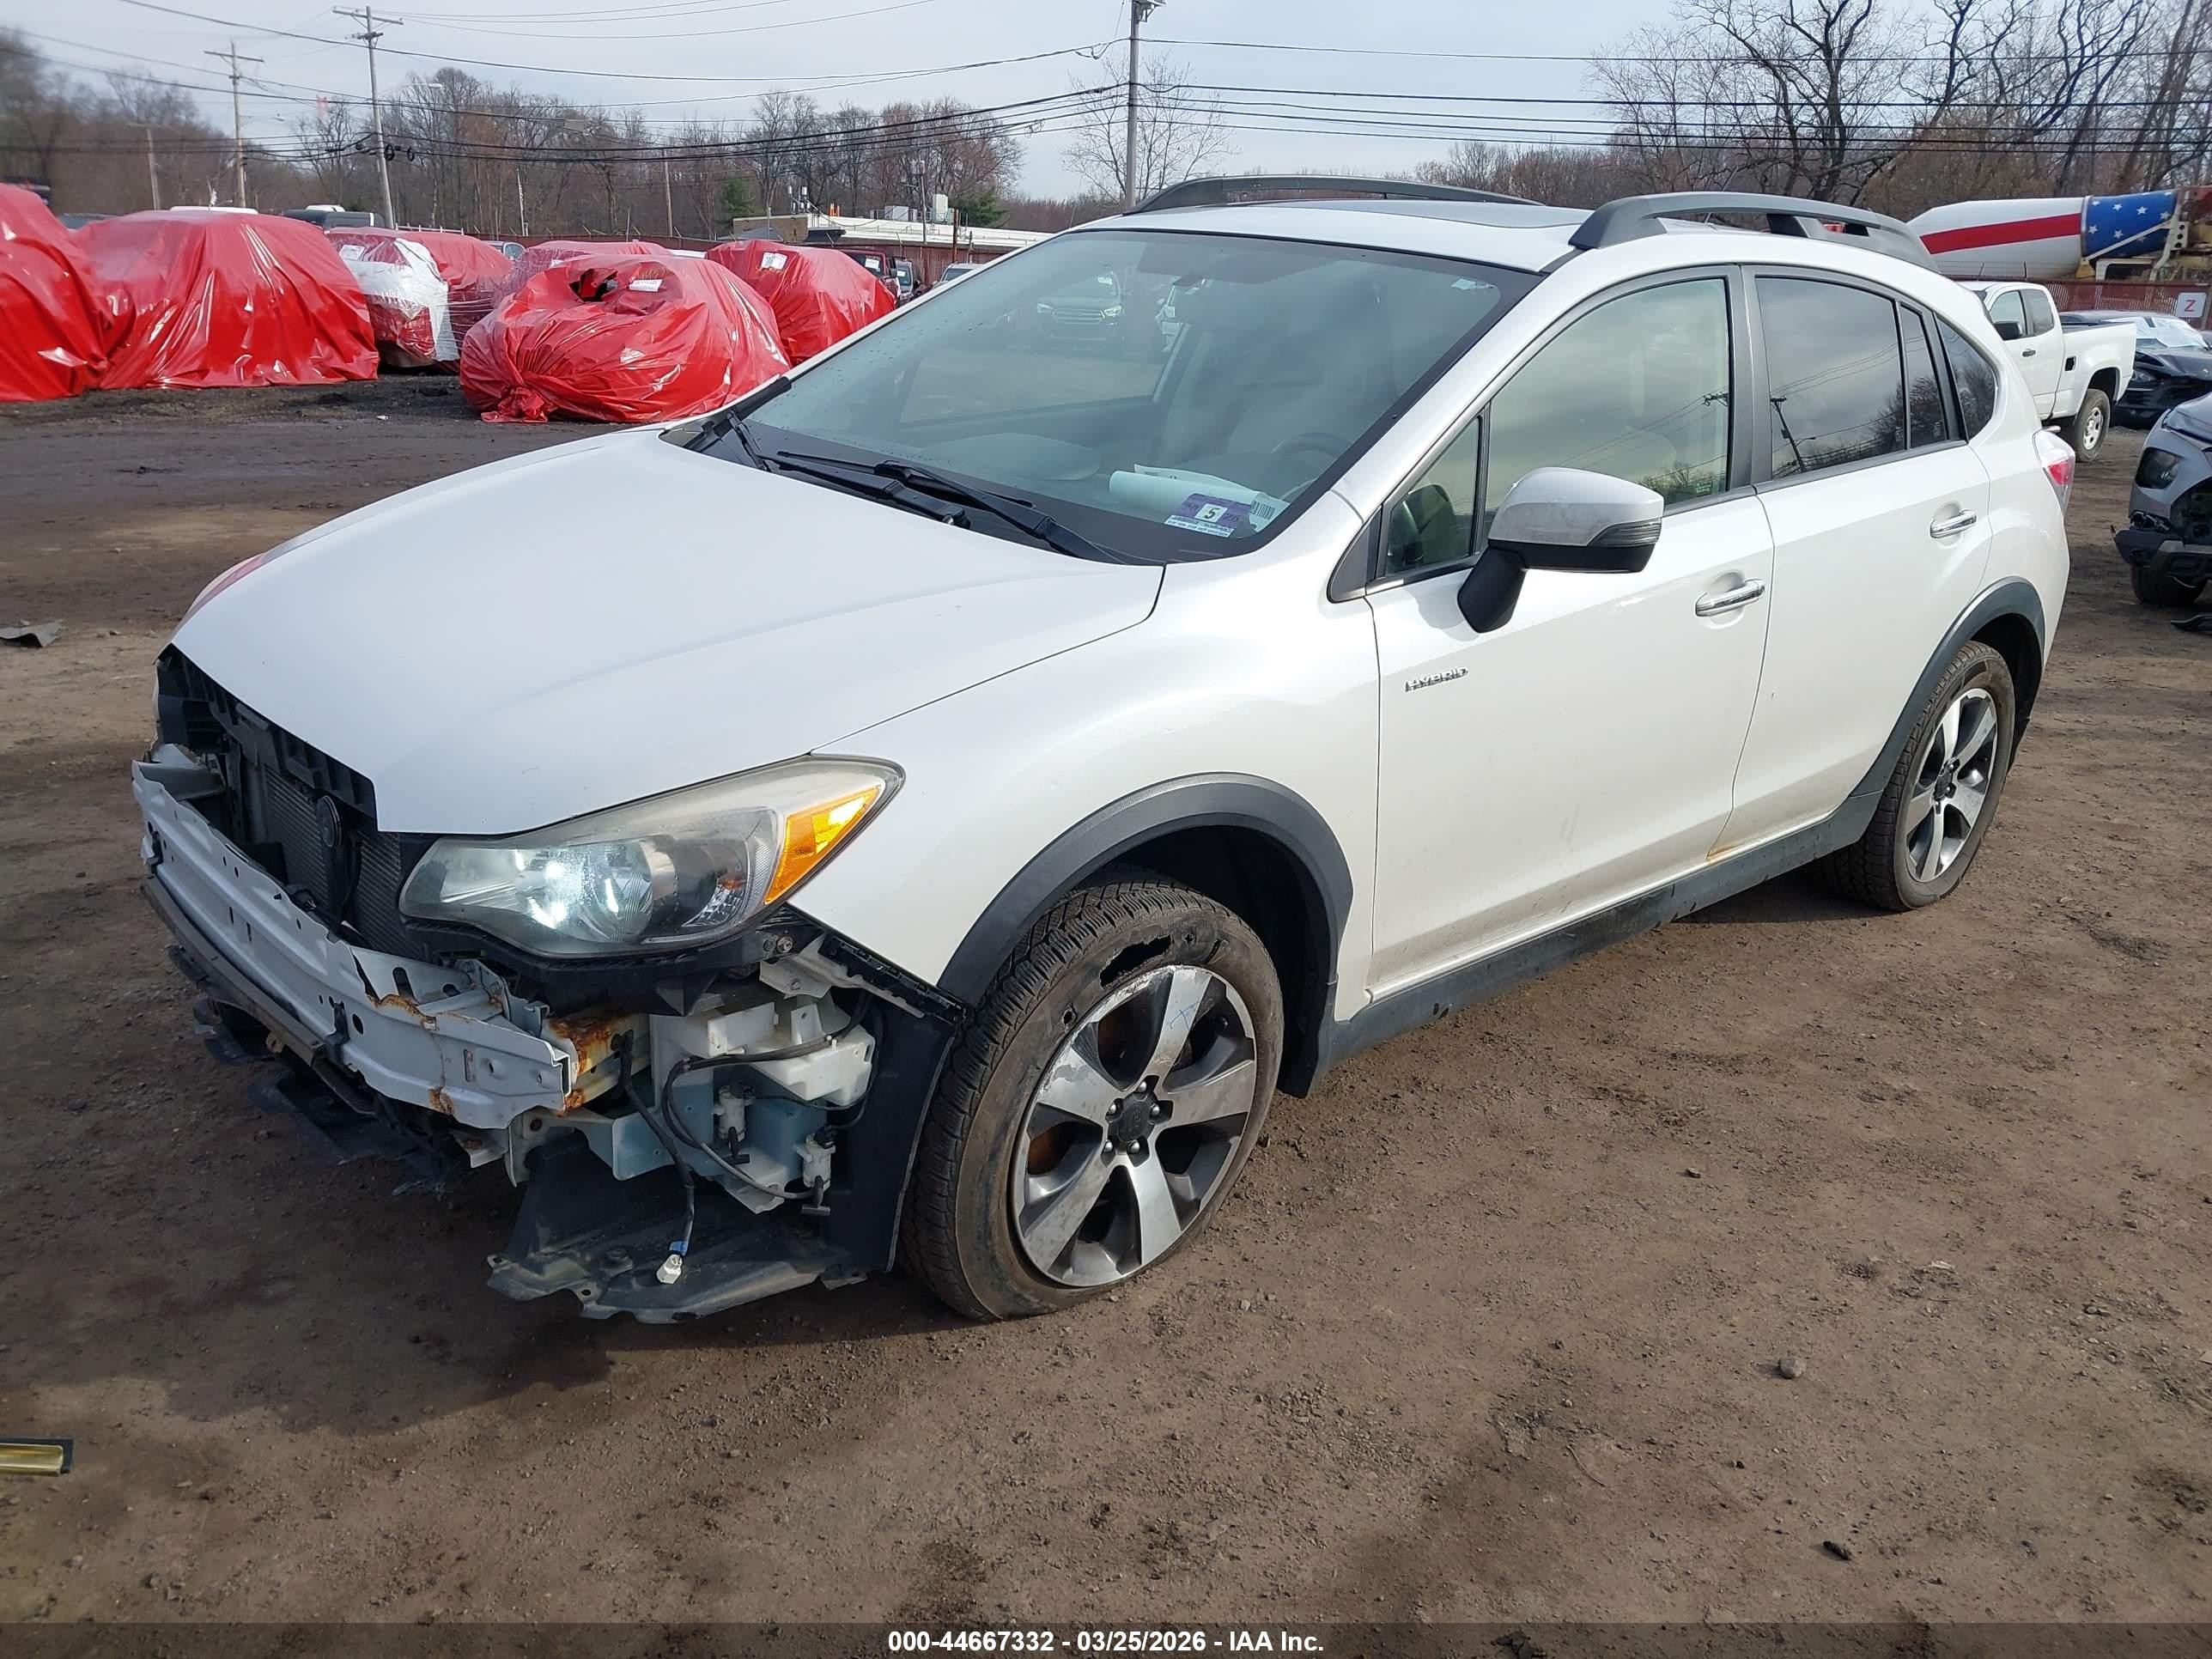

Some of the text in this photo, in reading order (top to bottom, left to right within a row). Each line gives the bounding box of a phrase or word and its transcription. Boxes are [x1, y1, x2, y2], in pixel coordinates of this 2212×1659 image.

[2184, 299, 2197, 313] Z
[1204, 507, 1220, 520] 5
[1404, 667, 1468, 692] HYBRID
